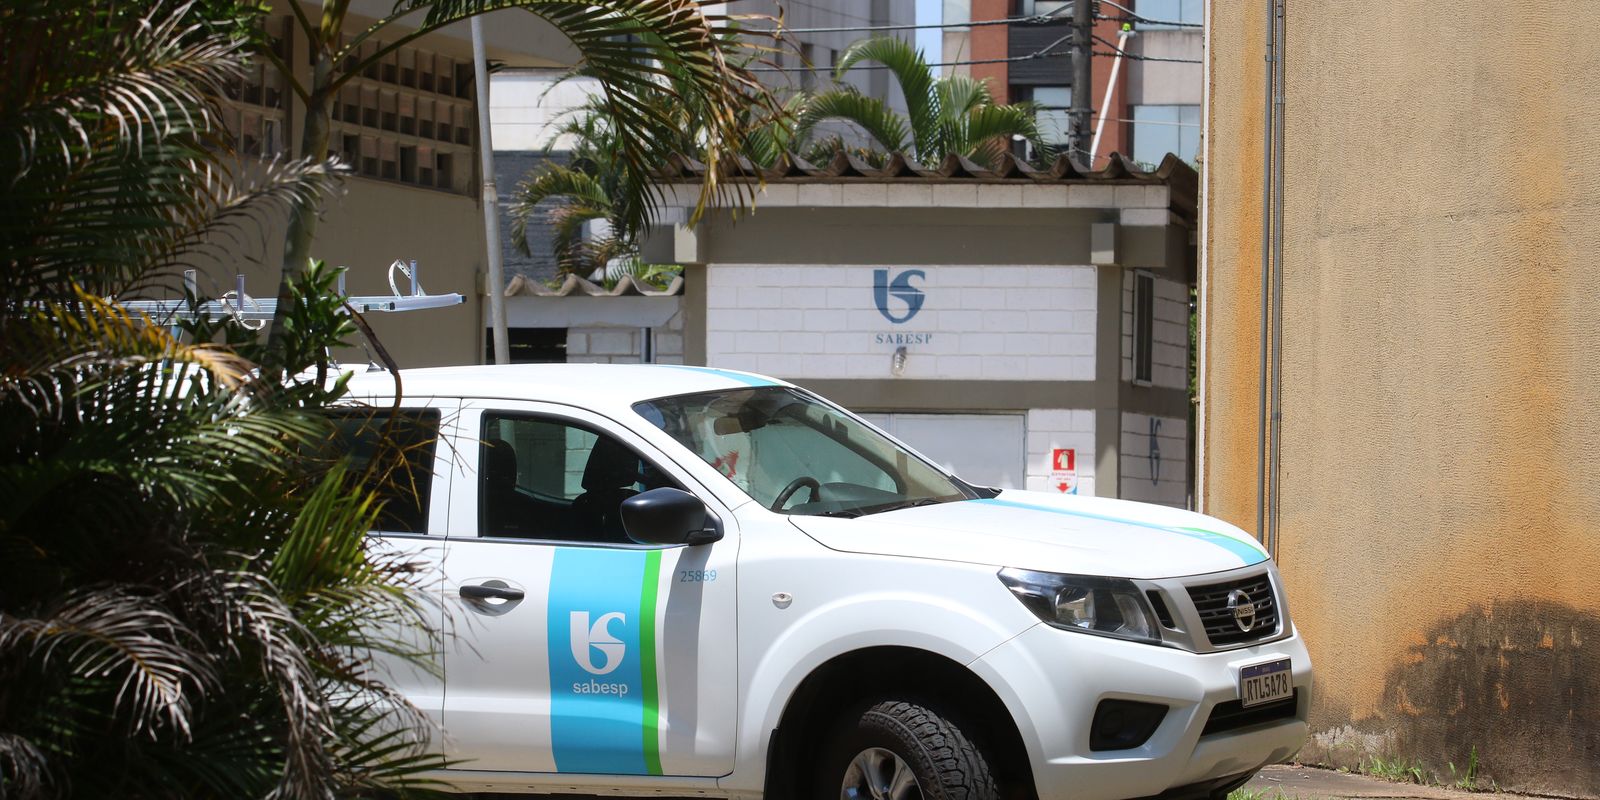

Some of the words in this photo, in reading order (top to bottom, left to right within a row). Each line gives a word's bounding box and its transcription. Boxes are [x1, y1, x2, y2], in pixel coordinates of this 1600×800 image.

[875, 333, 932, 344] SABESP
[680, 570, 717, 582] 25869
[573, 680, 628, 697] sabesp
[1247, 673, 1288, 701] RTL5A78
